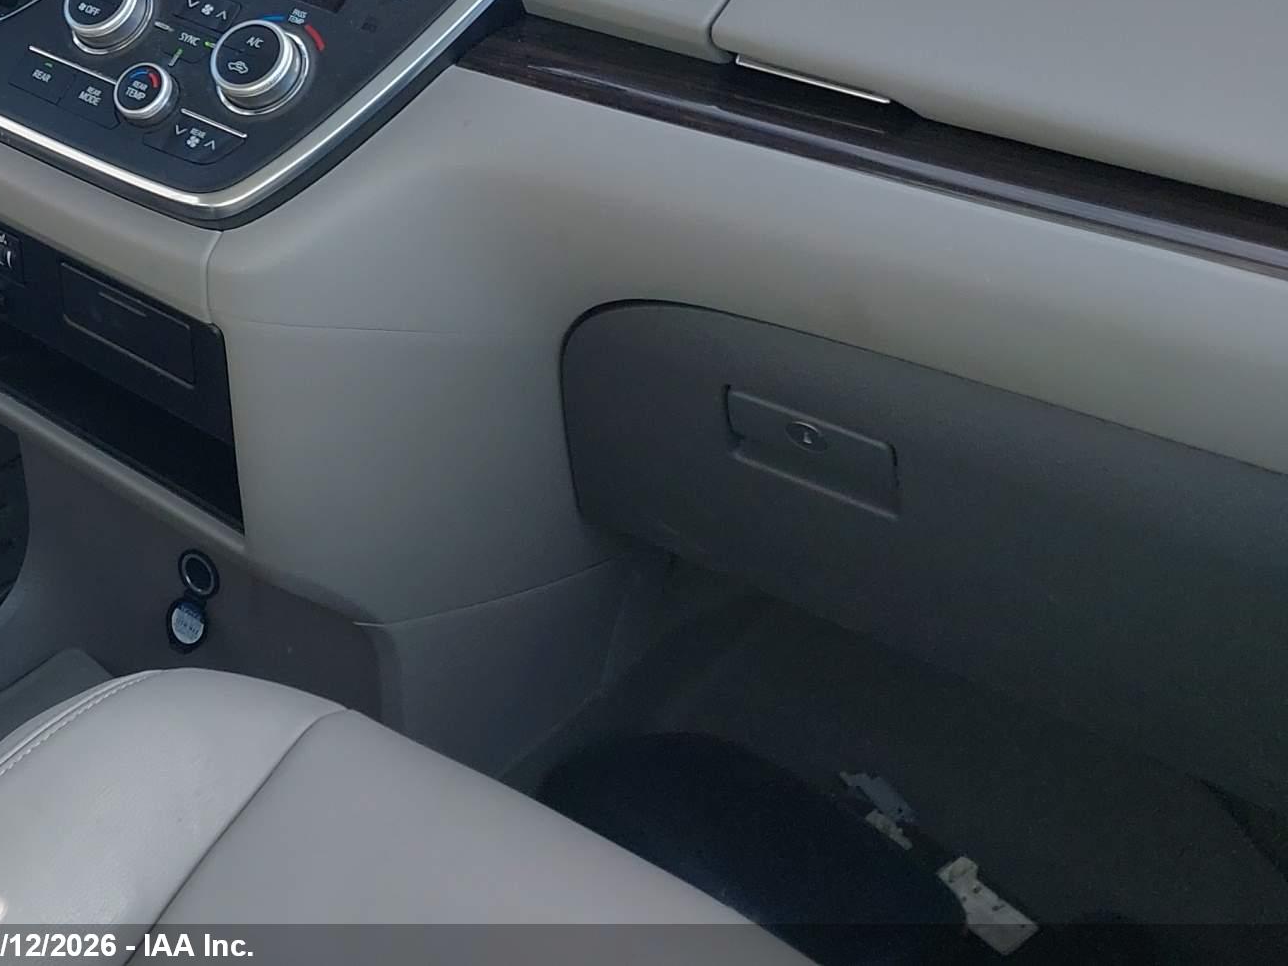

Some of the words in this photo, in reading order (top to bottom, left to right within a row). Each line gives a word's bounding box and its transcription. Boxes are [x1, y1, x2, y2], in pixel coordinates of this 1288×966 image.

[85, 4, 101, 16] OFF
[288, 15, 305, 25] TEMP
[178, 32, 200, 46] SYNC
[246, 36, 264, 48] A/C
[32, 69, 51, 83] REAR
[86, 86, 102, 97] REAR
[132, 80, 148, 91] REAR
[78, 91, 102, 106] MODE
[125, 87, 147, 101] TEMP
[190, 127, 207, 139] REAR
